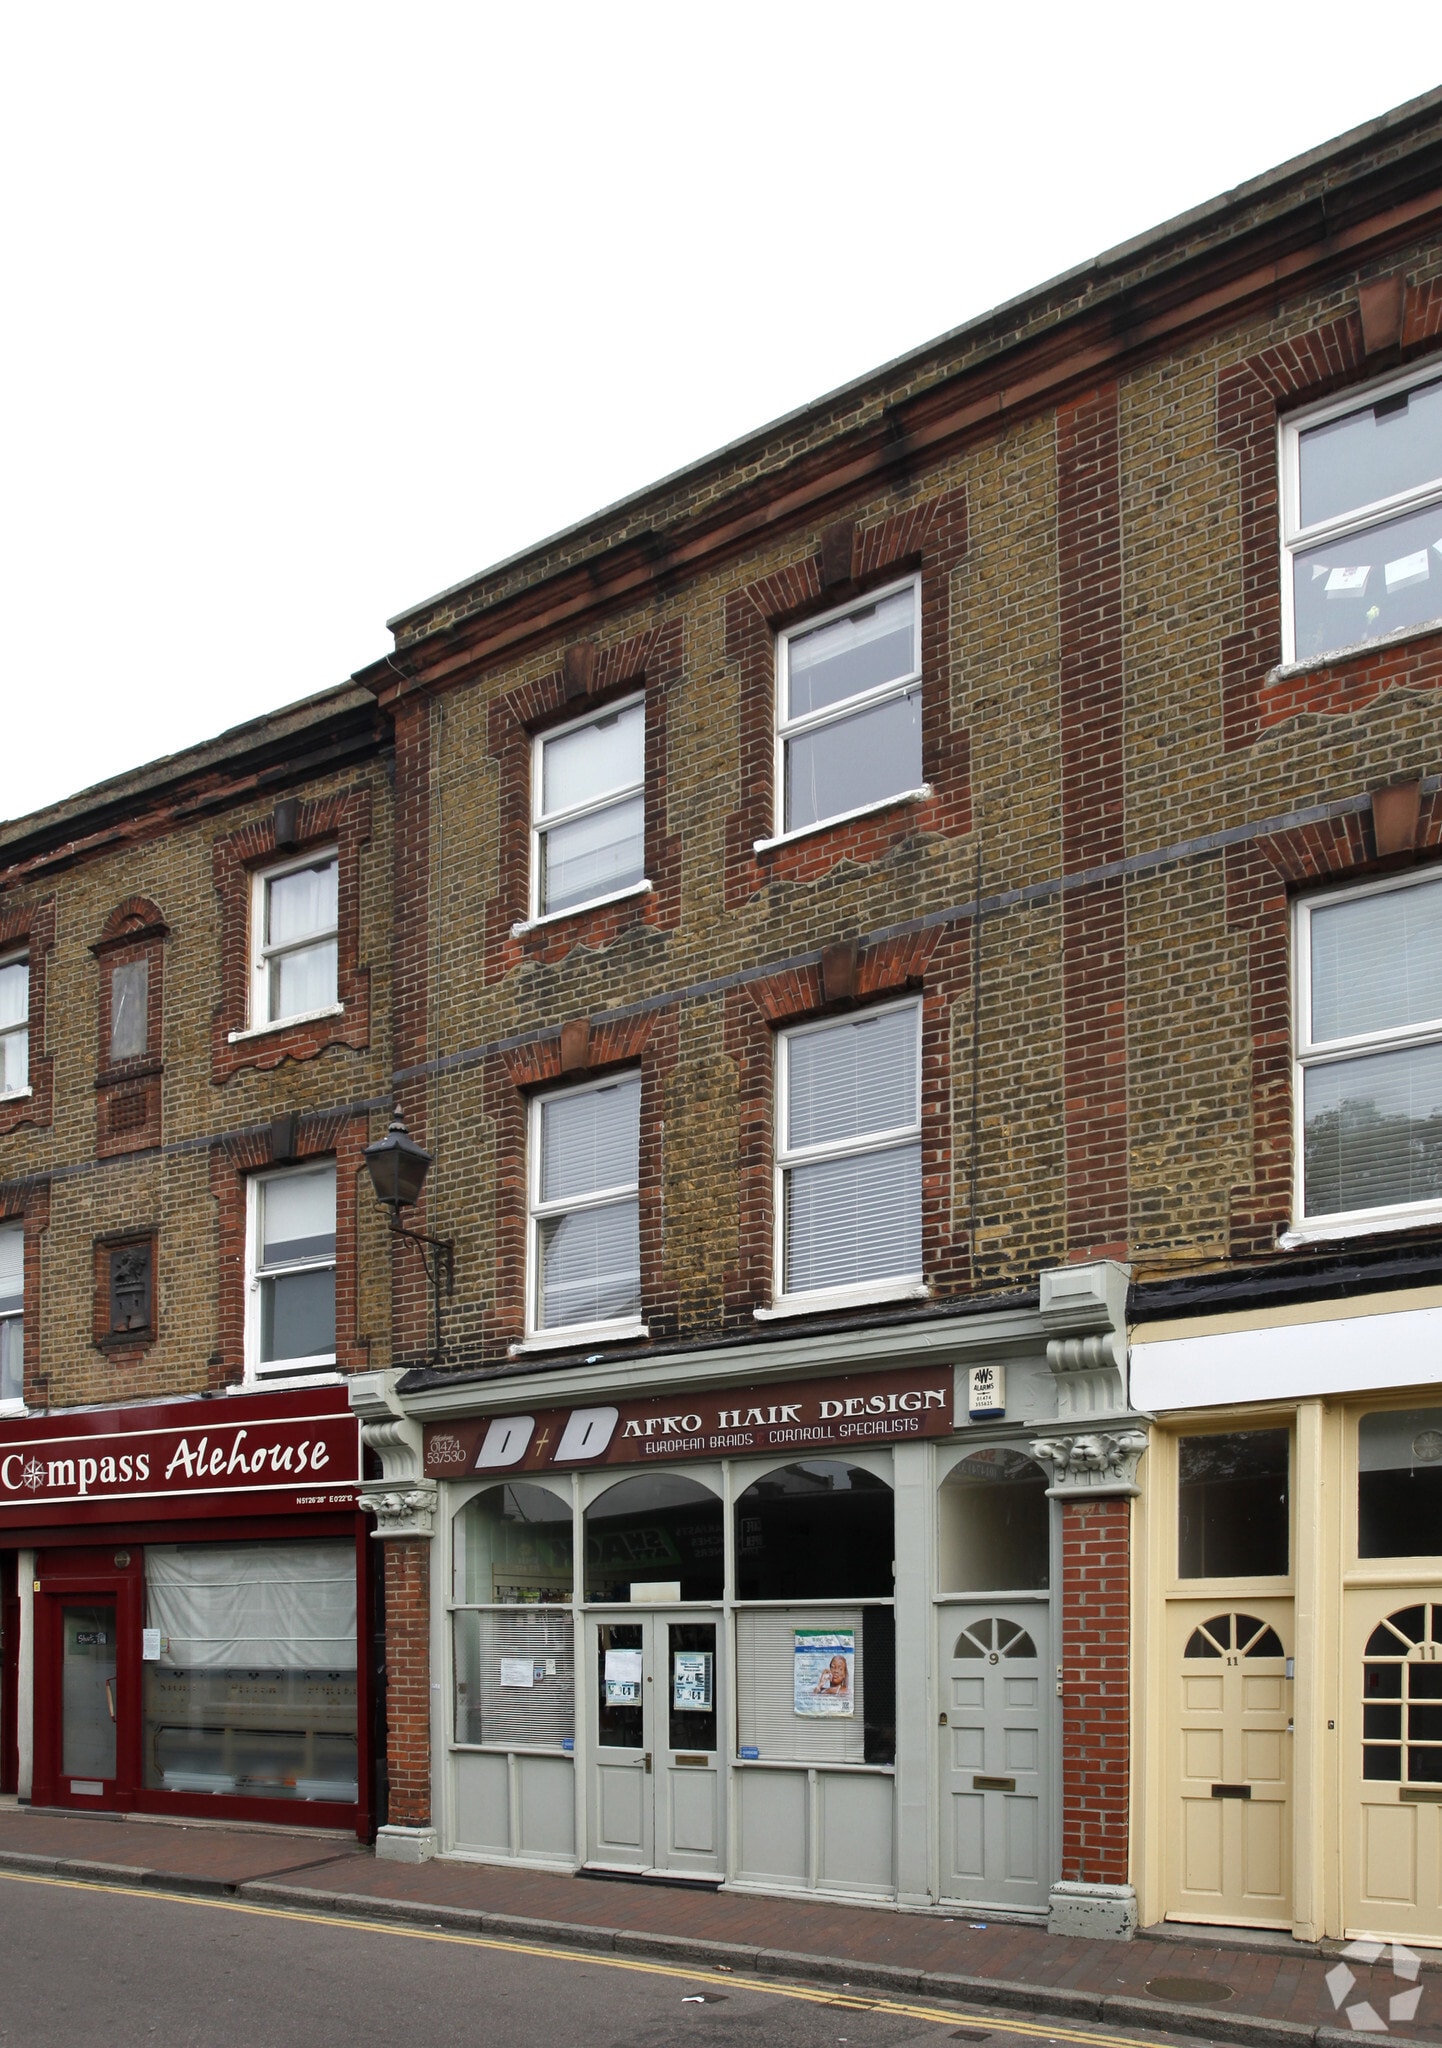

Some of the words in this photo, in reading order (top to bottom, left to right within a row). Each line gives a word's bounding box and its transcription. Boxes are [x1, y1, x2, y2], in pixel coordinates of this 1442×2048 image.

[974, 1368, 993, 1383] AWS
[973, 1383, 994, 1391] ALARMS
[475, 1415, 536, 1469] D
[554, 1406, 619, 1462] D
[621, 1414, 702, 1438] AFRO
[718, 1404, 803, 1429] HAIR
[819, 1388, 947, 1420] DESIGN
[645, 1437, 705, 1454] EUROPEAN
[709, 1433, 754, 1448] BRAIDS
[769, 1426, 835, 1443] CORNROLL
[839, 1417, 919, 1437] SPECIALISTS
[430, 1440, 460, 1452] 01474
[165, 1429, 330, 1480] Alehouse
[427, 1450, 467, 1464] 537530
[988, 1653, 999, 1665] 9
[1419, 1646, 1436, 1660] 11
[1226, 1656, 1239, 1666] 11
